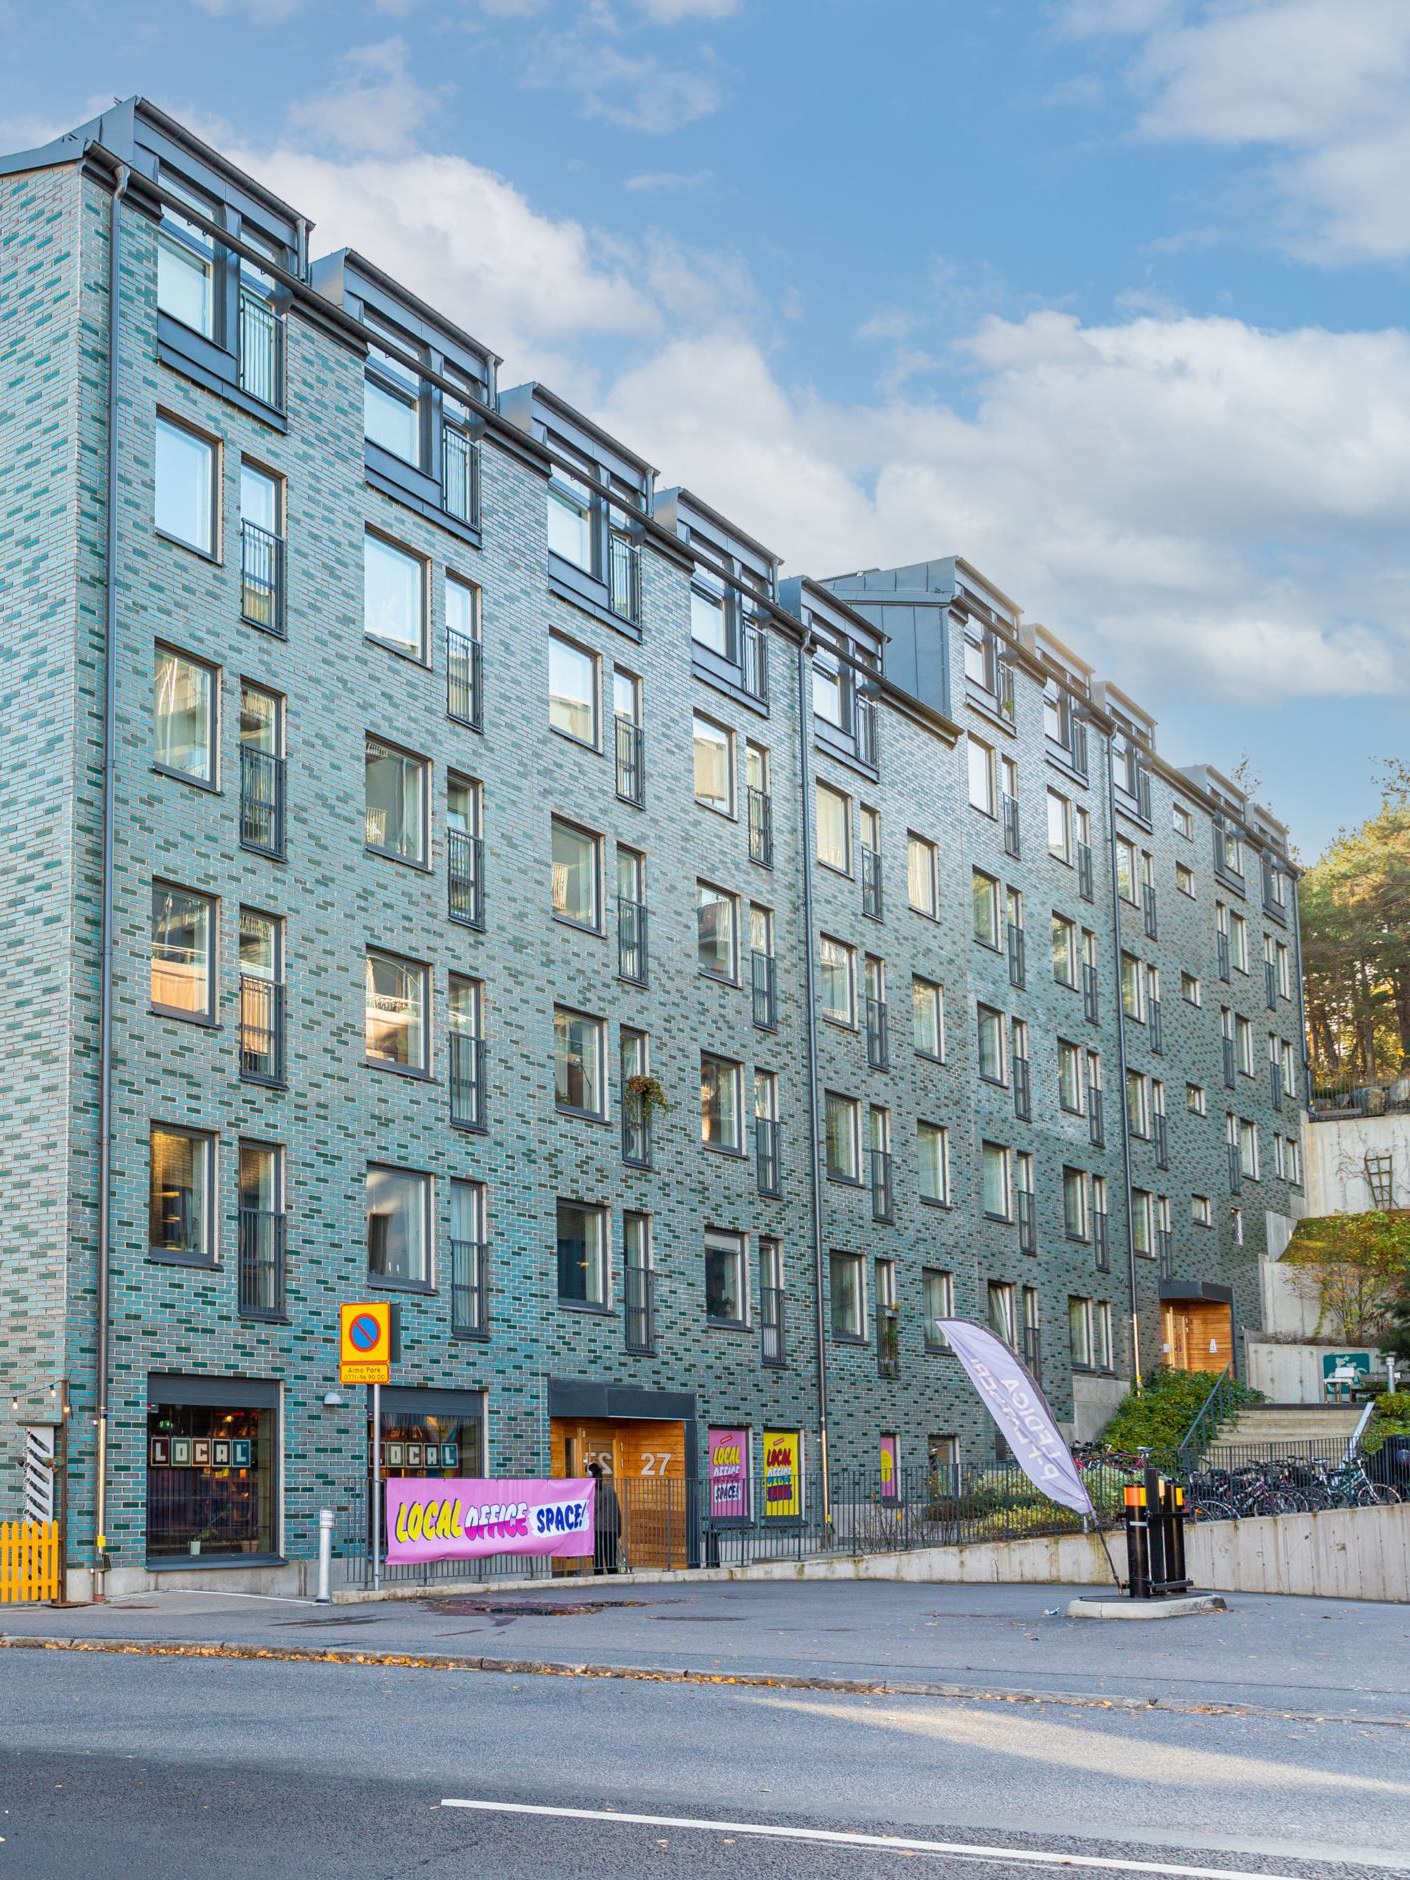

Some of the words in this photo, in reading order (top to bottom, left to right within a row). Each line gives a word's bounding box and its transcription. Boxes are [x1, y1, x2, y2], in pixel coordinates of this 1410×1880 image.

[155, 1442, 247, 1462] LOCAL
[713, 1445, 740, 1466] LOCAL
[767, 1448, 792, 1467] LOCAL
[640, 1453, 671, 1476] 27
[395, 1498, 463, 1543] LOCAL
[465, 1502, 529, 1541] OFFICE
[536, 1502, 588, 1535] SPACE!
